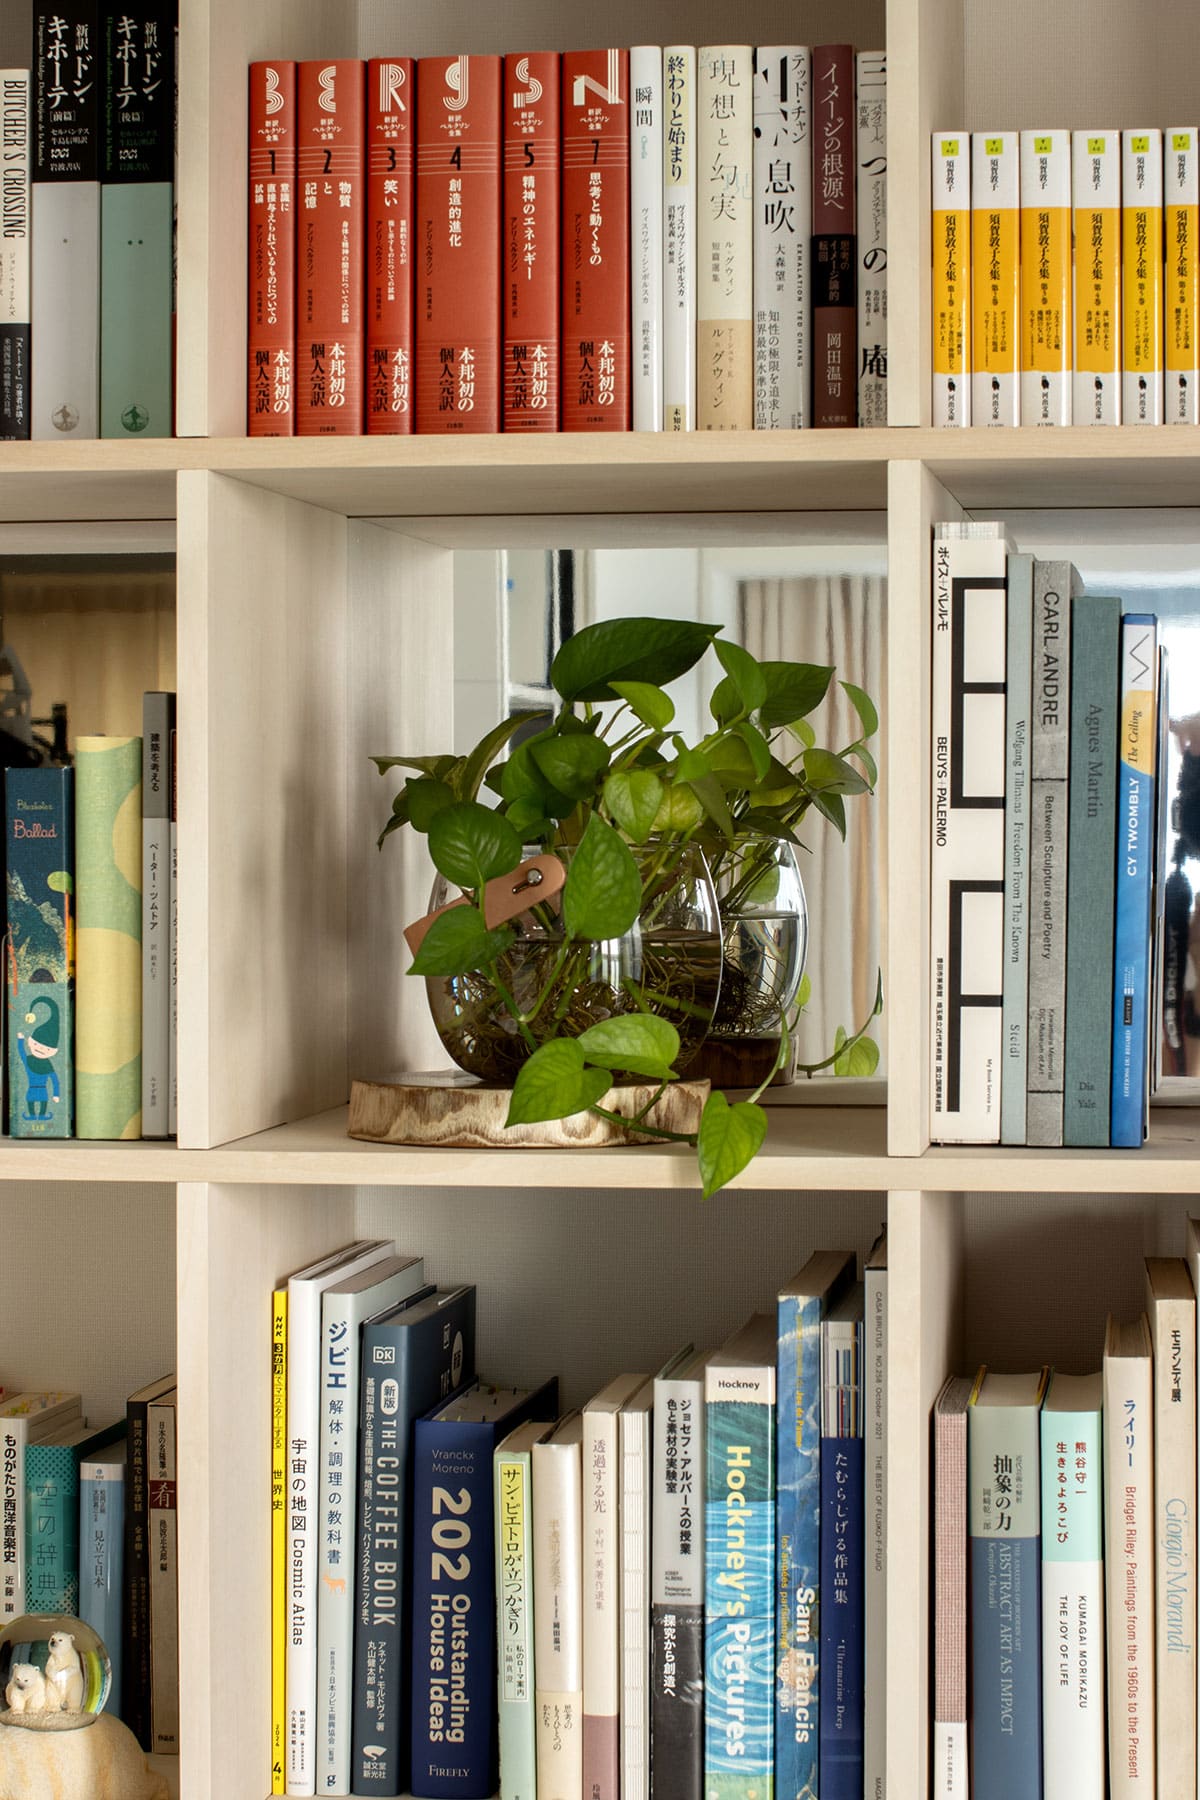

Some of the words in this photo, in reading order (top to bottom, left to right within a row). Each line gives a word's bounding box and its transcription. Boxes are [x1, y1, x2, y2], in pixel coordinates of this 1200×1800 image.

[47, 16, 69, 109] キホーテ
[116, 15, 138, 109] キホーテ
[379, 63, 407, 113] R
[513, 57, 543, 109] S
[573, 48, 625, 106] N
[265, 67, 285, 115] B
[635, 86, 653, 127] 瞬間
[667, 55, 686, 183] 終わりと始まり
[791, 54, 807, 144] テッド・チャン
[3, 80, 27, 160] BUTCHER'S
[709, 59, 741, 221] 現想と幻実
[820, 63, 846, 210] イメージの根源へ
[268, 150, 276, 175] 1
[322, 149, 332, 174] 2
[386, 147, 397, 172] 3
[449, 145, 461, 171] 4
[524, 142, 535, 168] 5
[591, 139, 600, 164] 7
[3, 168, 27, 238] CROSSING
[304, 182, 317, 209] 記憶
[323, 182, 333, 195] と
[339, 181, 352, 208] 物質
[383, 179, 399, 207] 笑い
[448, 178, 462, 247] 創造的進化
[765, 159, 795, 234] 息吹
[522, 175, 537, 281] 精神のエネルギー
[589, 172, 602, 267] 思考と動くもの
[945, 215, 957, 281] 須賀敦子全集
[989, 213, 1001, 281] 須賀敦子全集
[1038, 212, 1050, 279] 須賀敦子全集
[1091, 213, 1103, 280] 須賀敦子全集
[1136, 212, 1147, 279] 須賀敦子全集
[1176, 210, 1188, 277] 須賀敦子全集
[255, 351, 270, 414] 個人完訳
[273, 349, 290, 414] 本邦初の
[310, 343, 326, 408] 個人完訳
[329, 342, 345, 408] 本邦初の
[372, 349, 388, 413] 個人完訳
[391, 348, 409, 413] 本邦初の
[439, 347, 455, 412] 個人完訳
[457, 347, 476, 412] 本邦初の
[511, 345, 527, 409] 個人完訳
[530, 344, 548, 410] 本邦初の
[578, 341, 595, 406] 個人完訳
[598, 340, 615, 406] 本邦初の
[827, 333, 843, 398] 岡田温司
[1043, 591, 1060, 647] CARL
[1042, 653, 1059, 726] ANDRE
[1085, 704, 1103, 753] Agnes
[1128, 710, 1143, 743] Ceiling
[150, 733, 161, 792] 建築を考える
[936, 736, 948, 779] BEUYS
[1127, 747, 1138, 764] The
[936, 787, 948, 847] PALERMO
[1013, 770, 1024, 814] Tillmans
[1086, 761, 1103, 818] Martin
[1127, 777, 1139, 850] TWOMBLY
[14, 819, 58, 838] Ballad
[1045, 795, 1055, 842] Between
[150, 843, 159, 930] ペーター・ツムトア
[1012, 871, 1023, 899] From
[1042, 845, 1054, 897] Sculpture
[1127, 854, 1139, 877] CY
[1011, 904, 1022, 923] The
[1044, 898, 1053, 919] and
[1011, 926, 1022, 963] Known
[1041, 920, 1053, 960] Poetry
[1010, 1024, 1020, 1058] Steidl
[275, 1316, 283, 1337] NHK
[326, 1321, 350, 1388] ジビエ
[376, 1351, 393, 1360] DK
[1170, 1330, 1182, 1403] モランディ展
[718, 1379, 760, 1391] Hockney
[875, 1388, 883, 1418] October
[381, 1420, 397, 1449] THE
[432, 1449, 475, 1460] Vranckx
[666, 1398, 677, 1494] 色と素材の実験室
[1123, 1400, 1137, 1468] ライリー
[151, 1482, 175, 1508] 肴
[272, 1469, 283, 1511] 世界史
[291, 1438, 307, 1531] 宇宙の地図
[327, 1399, 344, 1565] 解体・調理の教科書
[432, 1463, 475, 1474] Moreno
[592, 1439, 606, 1513] 透過する光
[679, 1399, 692, 1555] ジョセフ・アルバースの授業
[993, 1455, 1013, 1531] 抽象の力
[1056, 1441, 1069, 1543] 生きるよろこび
[1075, 1441, 1087, 1494] 熊谷守一
[3, 1434, 16, 1564] ものがたり西洋音楽史
[375, 1456, 400, 1550] COFFEE
[875, 1496, 882, 1504] OF
[1123, 1486, 1137, 1525] Bridget
[36, 1485, 58, 1596] 空の辞典
[431, 1486, 472, 1581] 202
[503, 1468, 523, 1635] サン・ピエトロが立つかぎり
[719, 1445, 753, 1616] Hockney's
[782, 1535, 790, 1549] les
[834, 1452, 848, 1604] たむらしげる作品集
[1126, 1528, 1137, 1558] Riley:
[1163, 1498, 1188, 1567] Giorgio
[292, 1539, 306, 1598] Cosmic
[373, 1561, 397, 1626] BOOK
[999, 1542, 1012, 1621] ABSTRACT
[1124, 1562, 1138, 1611] Paintings
[292, 1603, 305, 1646] Atlas
[430, 1594, 450, 1672] House
[796, 1587, 815, 1643] Sam
[1059, 1595, 1068, 1616] THE
[1059, 1619, 1068, 1641] JOY
[1078, 1595, 1087, 1646] KUMAGAI
[1127, 1615, 1137, 1641] from
[1166, 1570, 1191, 1654] Morandi
[664, 1614, 677, 1697] 探究から創造へ
[1000, 1624, 1013, 1653] ART
[1000, 1656, 1013, 1674] AS
[1059, 1644, 1068, 1660] OF
[1127, 1642, 1137, 1662] the
[446, 1594, 471, 1743] Outstanding
[516, 1645, 524, 1697] 私のローマ案内
[725, 1623, 751, 1757] Pictures
[837, 1644, 845, 1702] Ultramarine
[1059, 1663, 1069, 1686] LIFE
[1078, 1650, 1088, 1709] MORIKAZU
[1127, 1666, 1139, 1699] 1960s
[429, 1678, 449, 1743] Ideas
[543, 1704, 551, 1728] かたち
[563, 1704, 573, 1729] 思考の
[795, 1652, 815, 1744] Francis
[835, 1705, 845, 1729] Deep
[1000, 1678, 1013, 1735] IMPACT
[1128, 1703, 1138, 1713] to
[1128, 1715, 1138, 1733] the
[376, 1722, 385, 1732] 著
[552, 1704, 562, 1751] もうひとつの
[1128, 1736, 1140, 1779] Present
